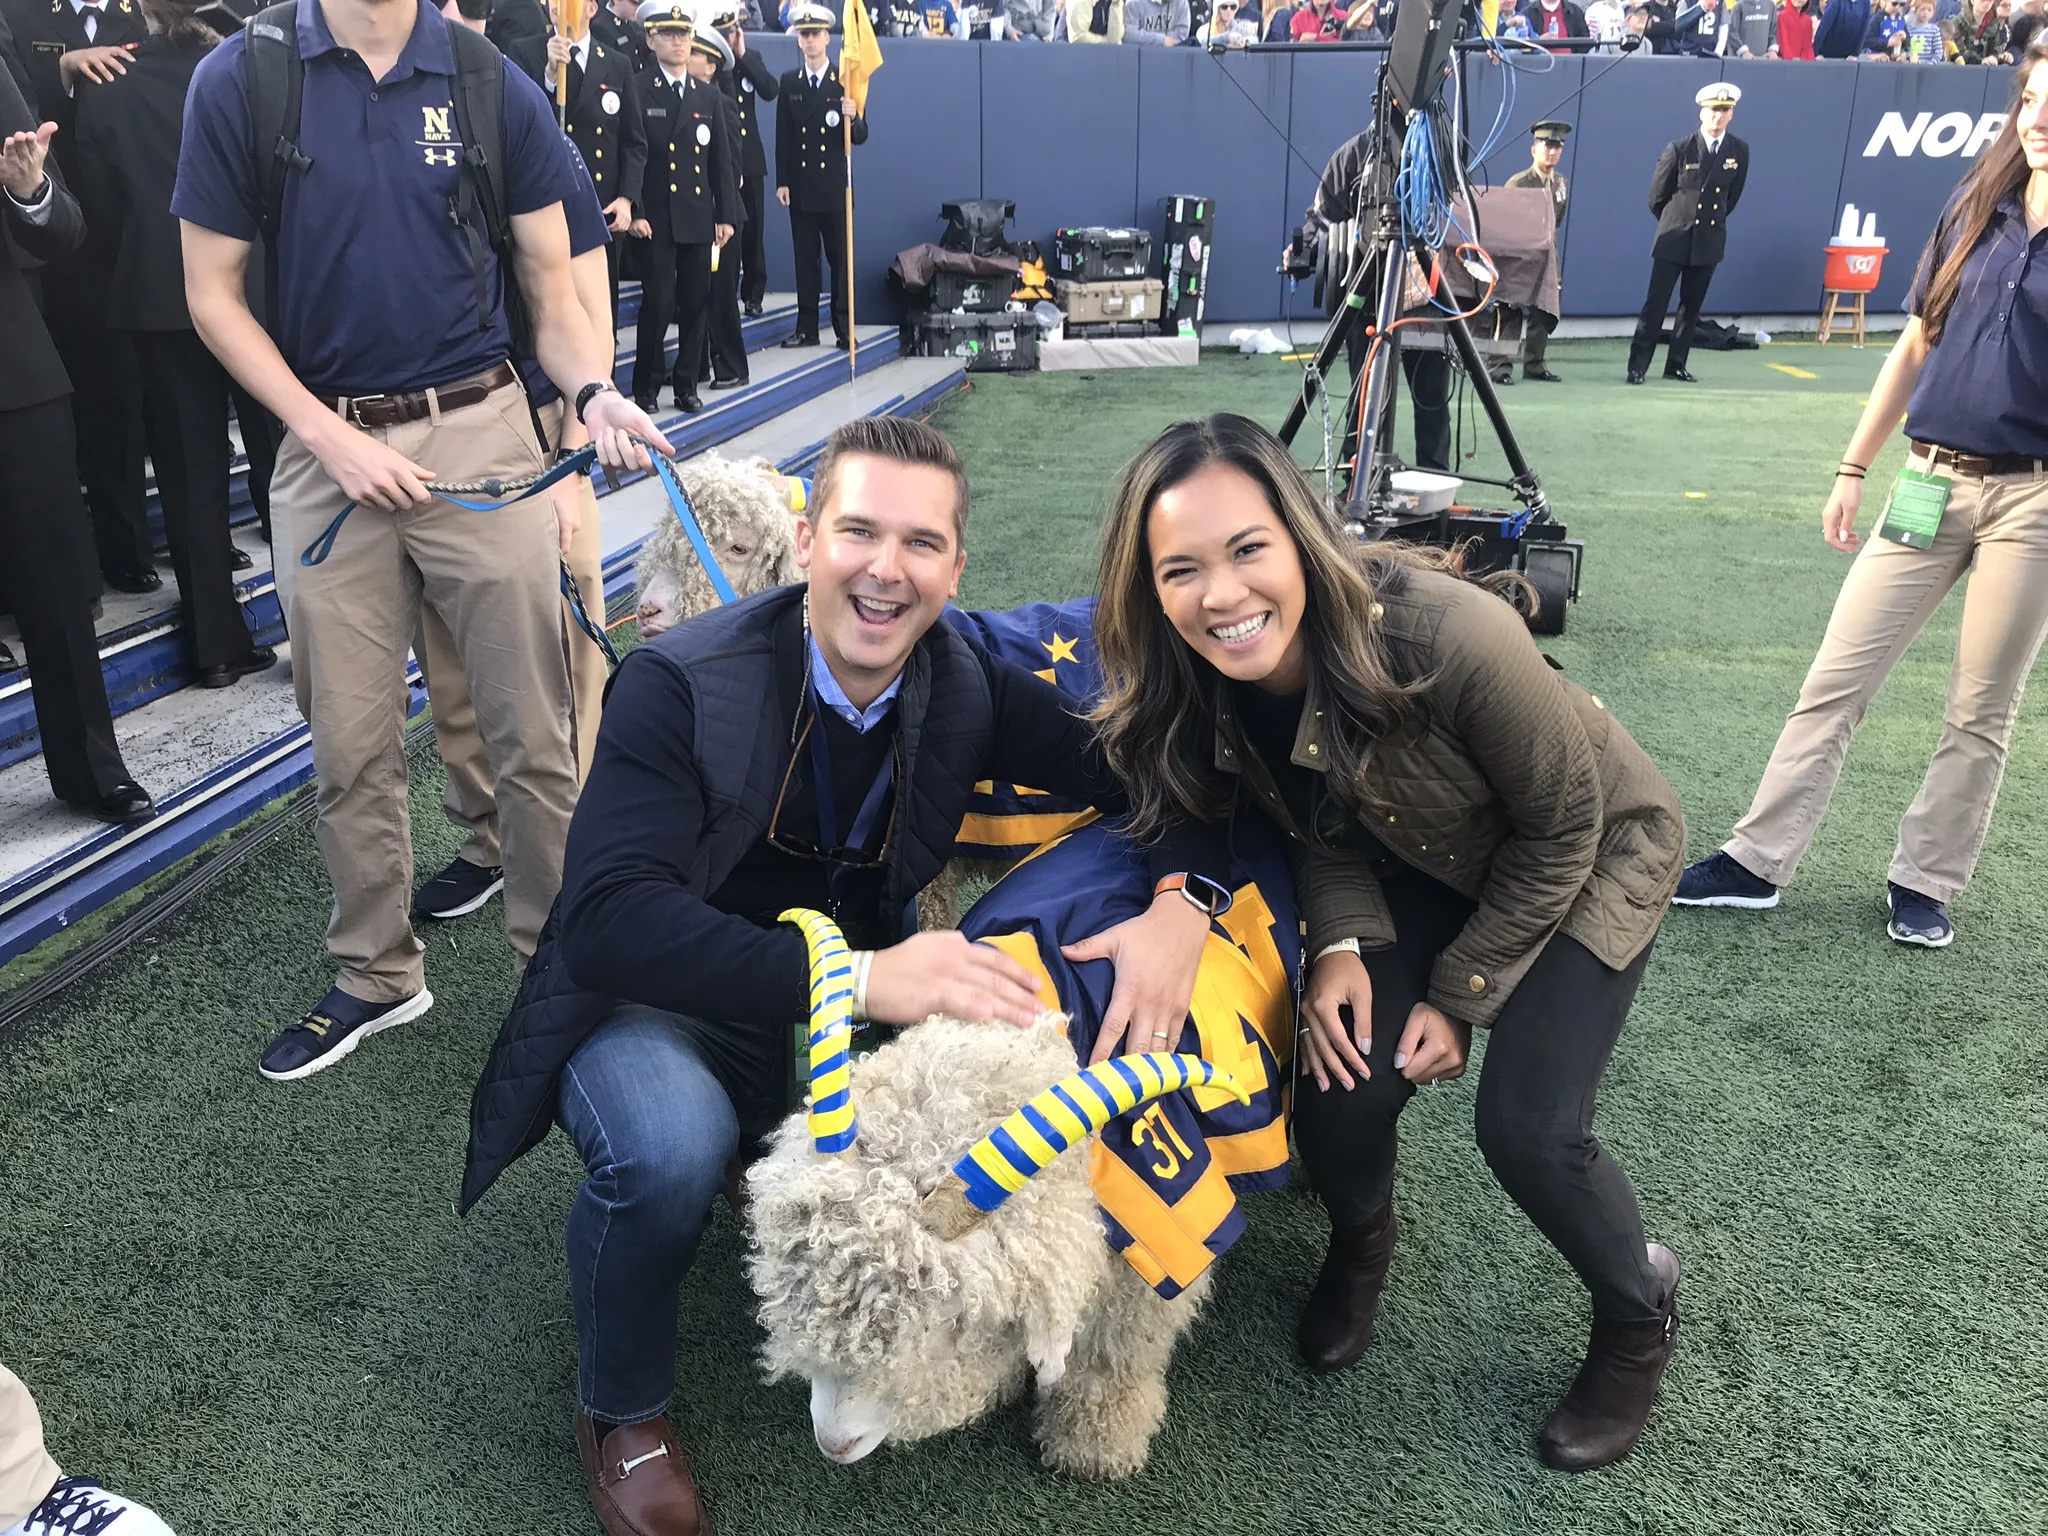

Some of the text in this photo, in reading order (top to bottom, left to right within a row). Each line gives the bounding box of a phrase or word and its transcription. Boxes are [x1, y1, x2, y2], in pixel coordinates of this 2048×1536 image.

[1698, 11, 1716, 35] 12
[422, 107, 451, 133] N
[1132, 1101, 1194, 1179] 37
